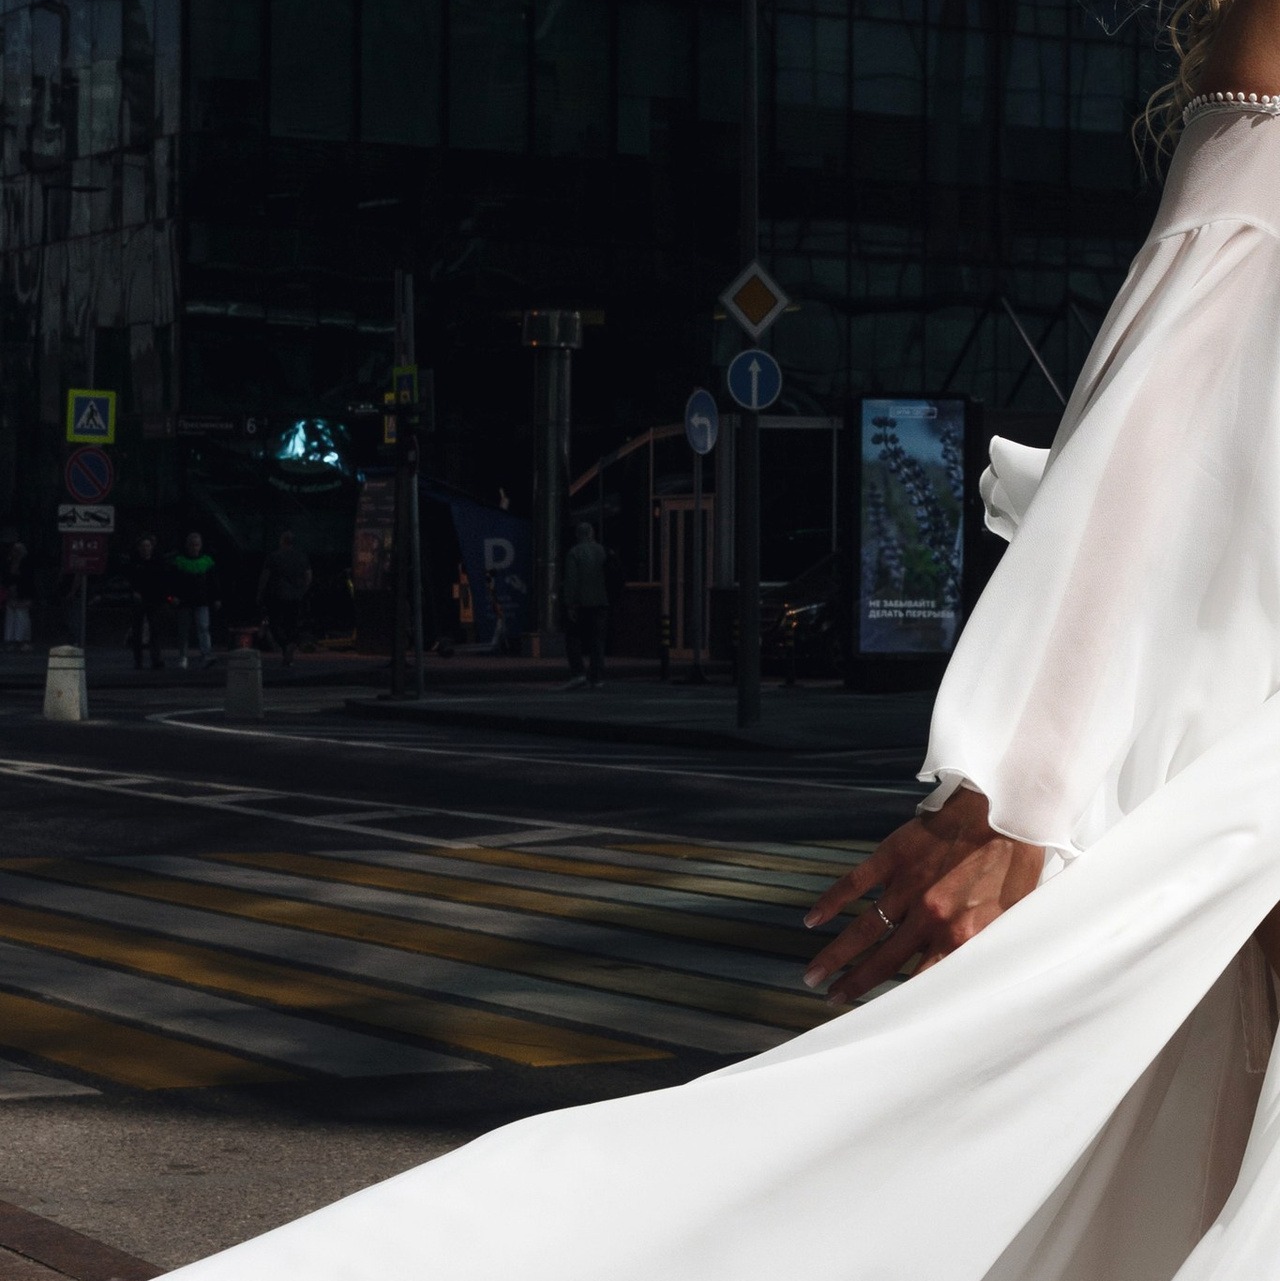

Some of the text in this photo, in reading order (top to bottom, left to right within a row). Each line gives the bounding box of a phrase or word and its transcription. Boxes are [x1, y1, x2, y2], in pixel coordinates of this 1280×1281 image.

[869, 599, 936, 608] НЕ ЗАБЫВАЙТЕ
[869, 609, 904, 619] ДЕЛАТЬ
